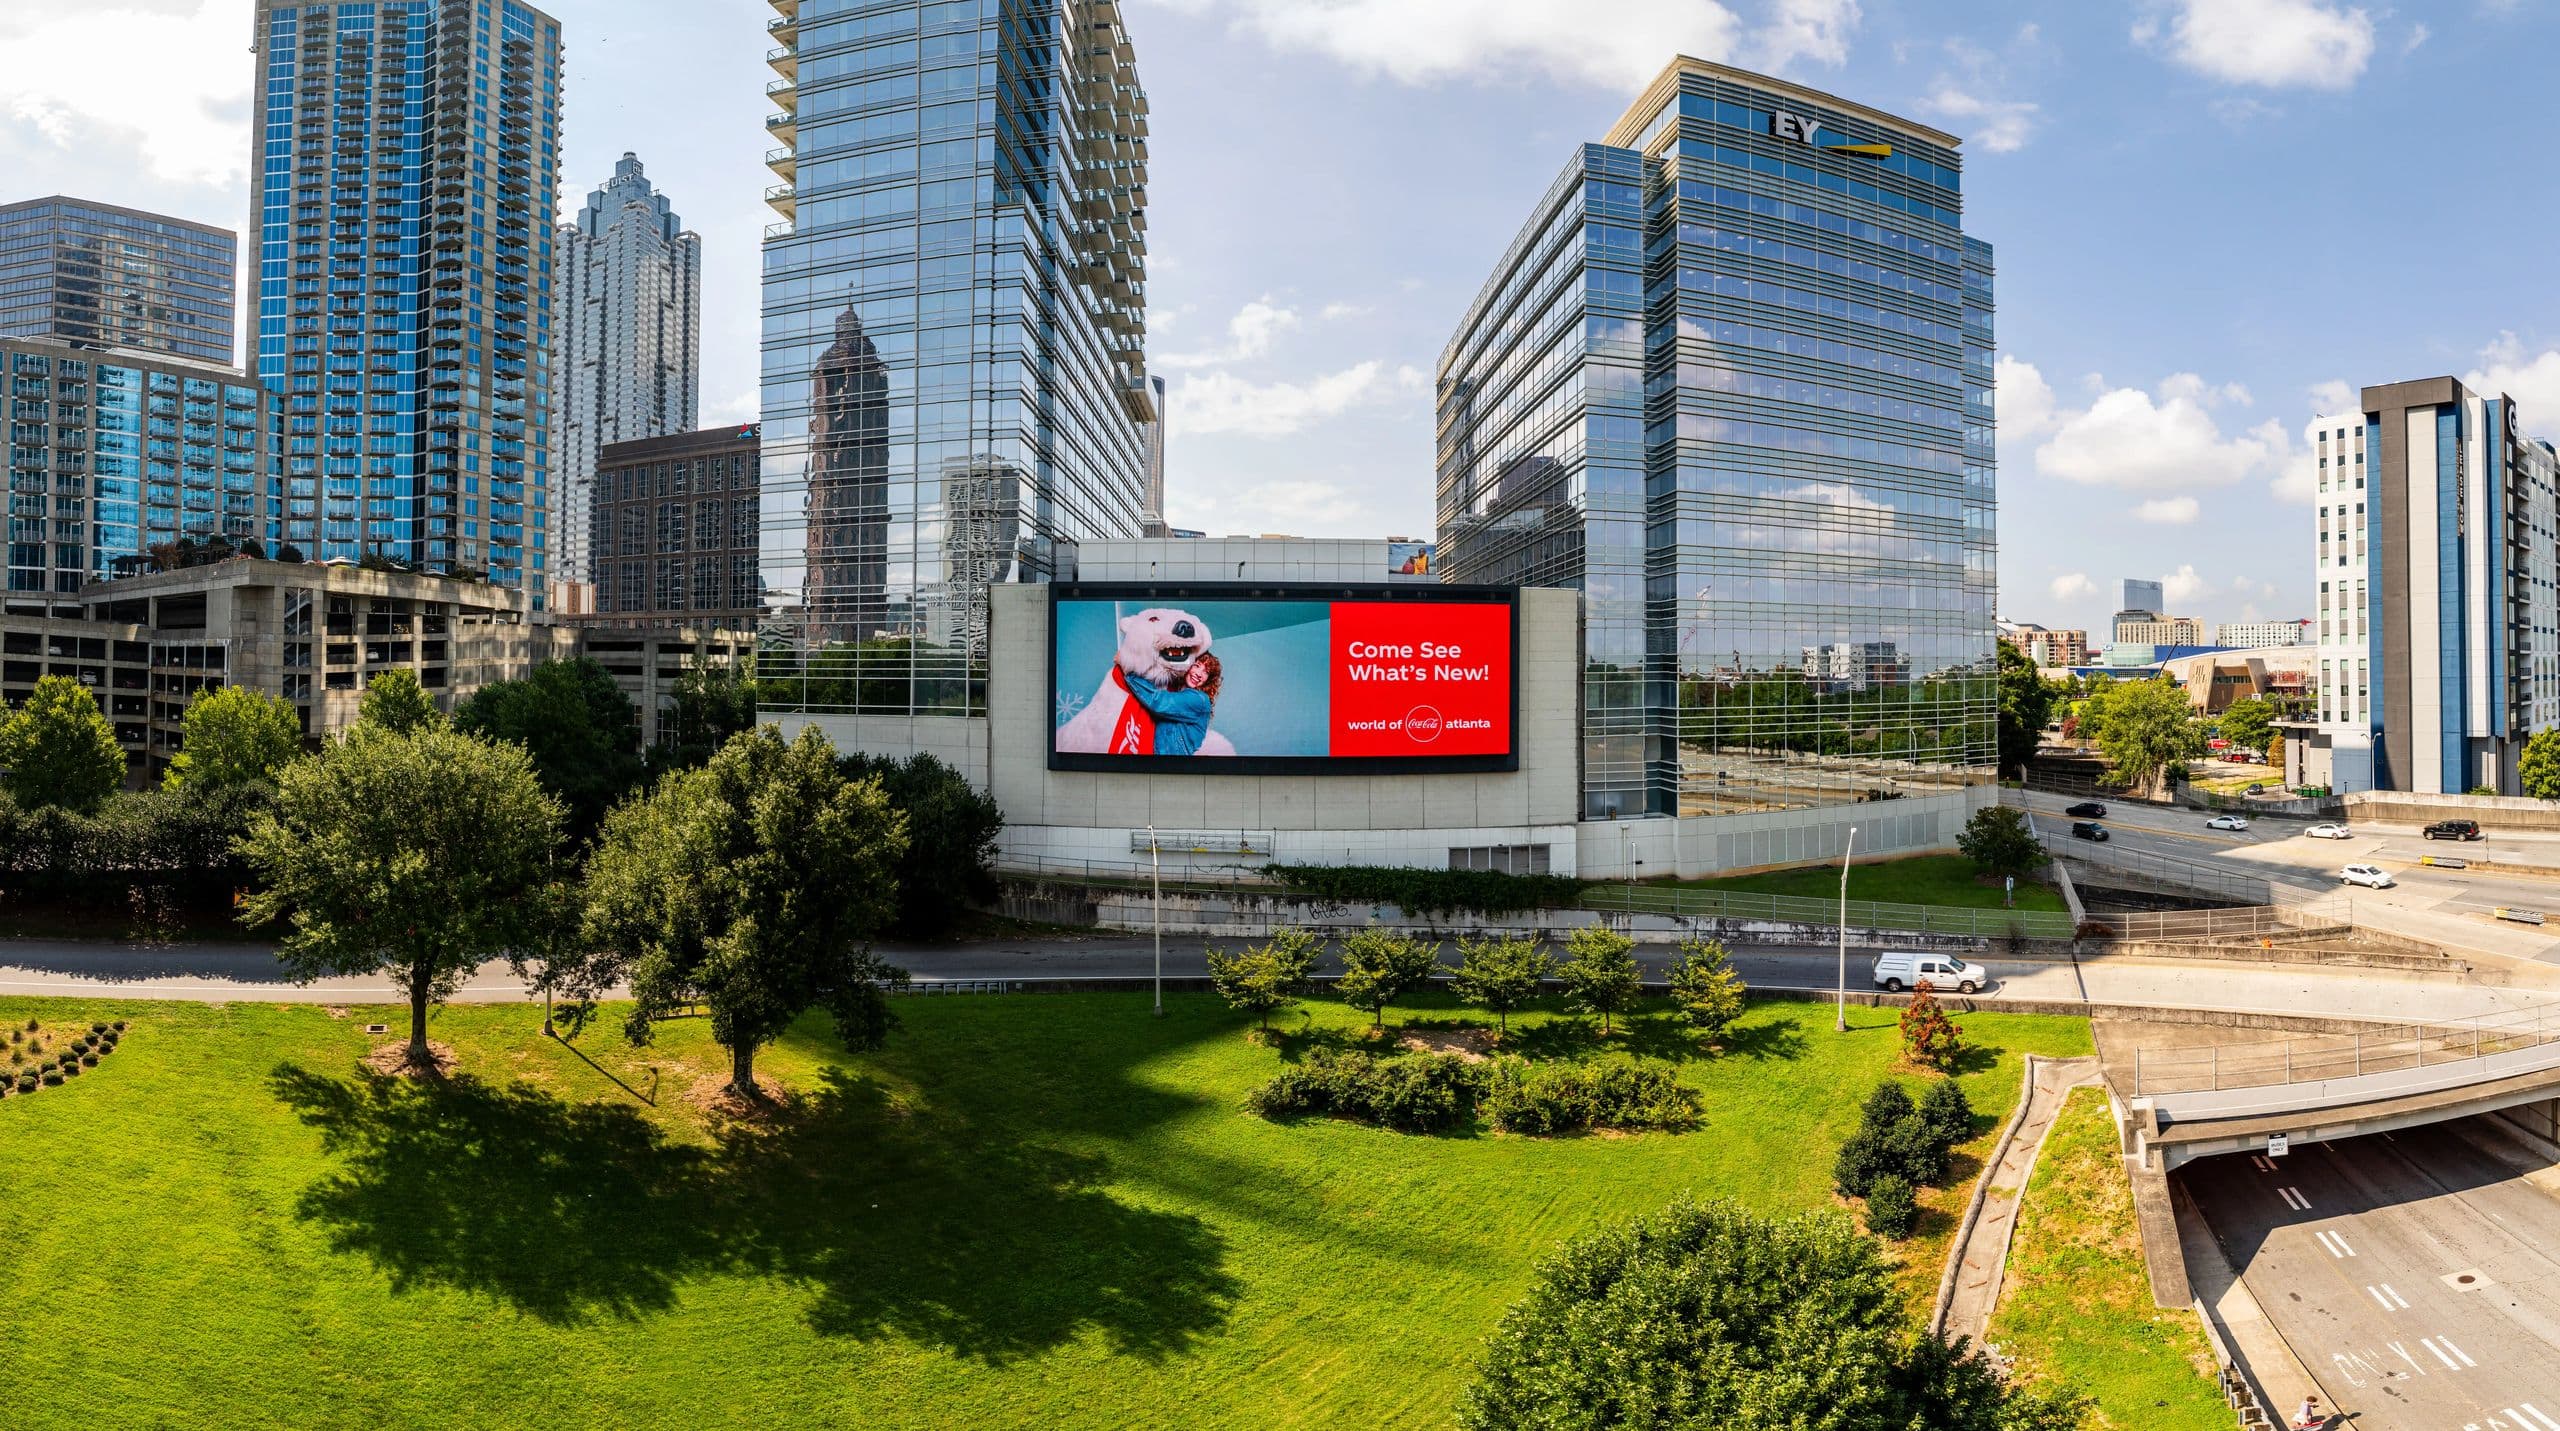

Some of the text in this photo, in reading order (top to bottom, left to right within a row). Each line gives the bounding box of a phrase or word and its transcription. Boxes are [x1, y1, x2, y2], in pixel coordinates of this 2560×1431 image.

[1775, 109, 1822, 145] EY
[598, 173, 634, 190] TRUIST
[1348, 641, 1462, 659] Come See
[1348, 664, 1489, 681] What’s New!
[1348, 719, 1386, 730] world
[1389, 719, 1403, 730] of
[1445, 719, 1491, 729] atlanta
